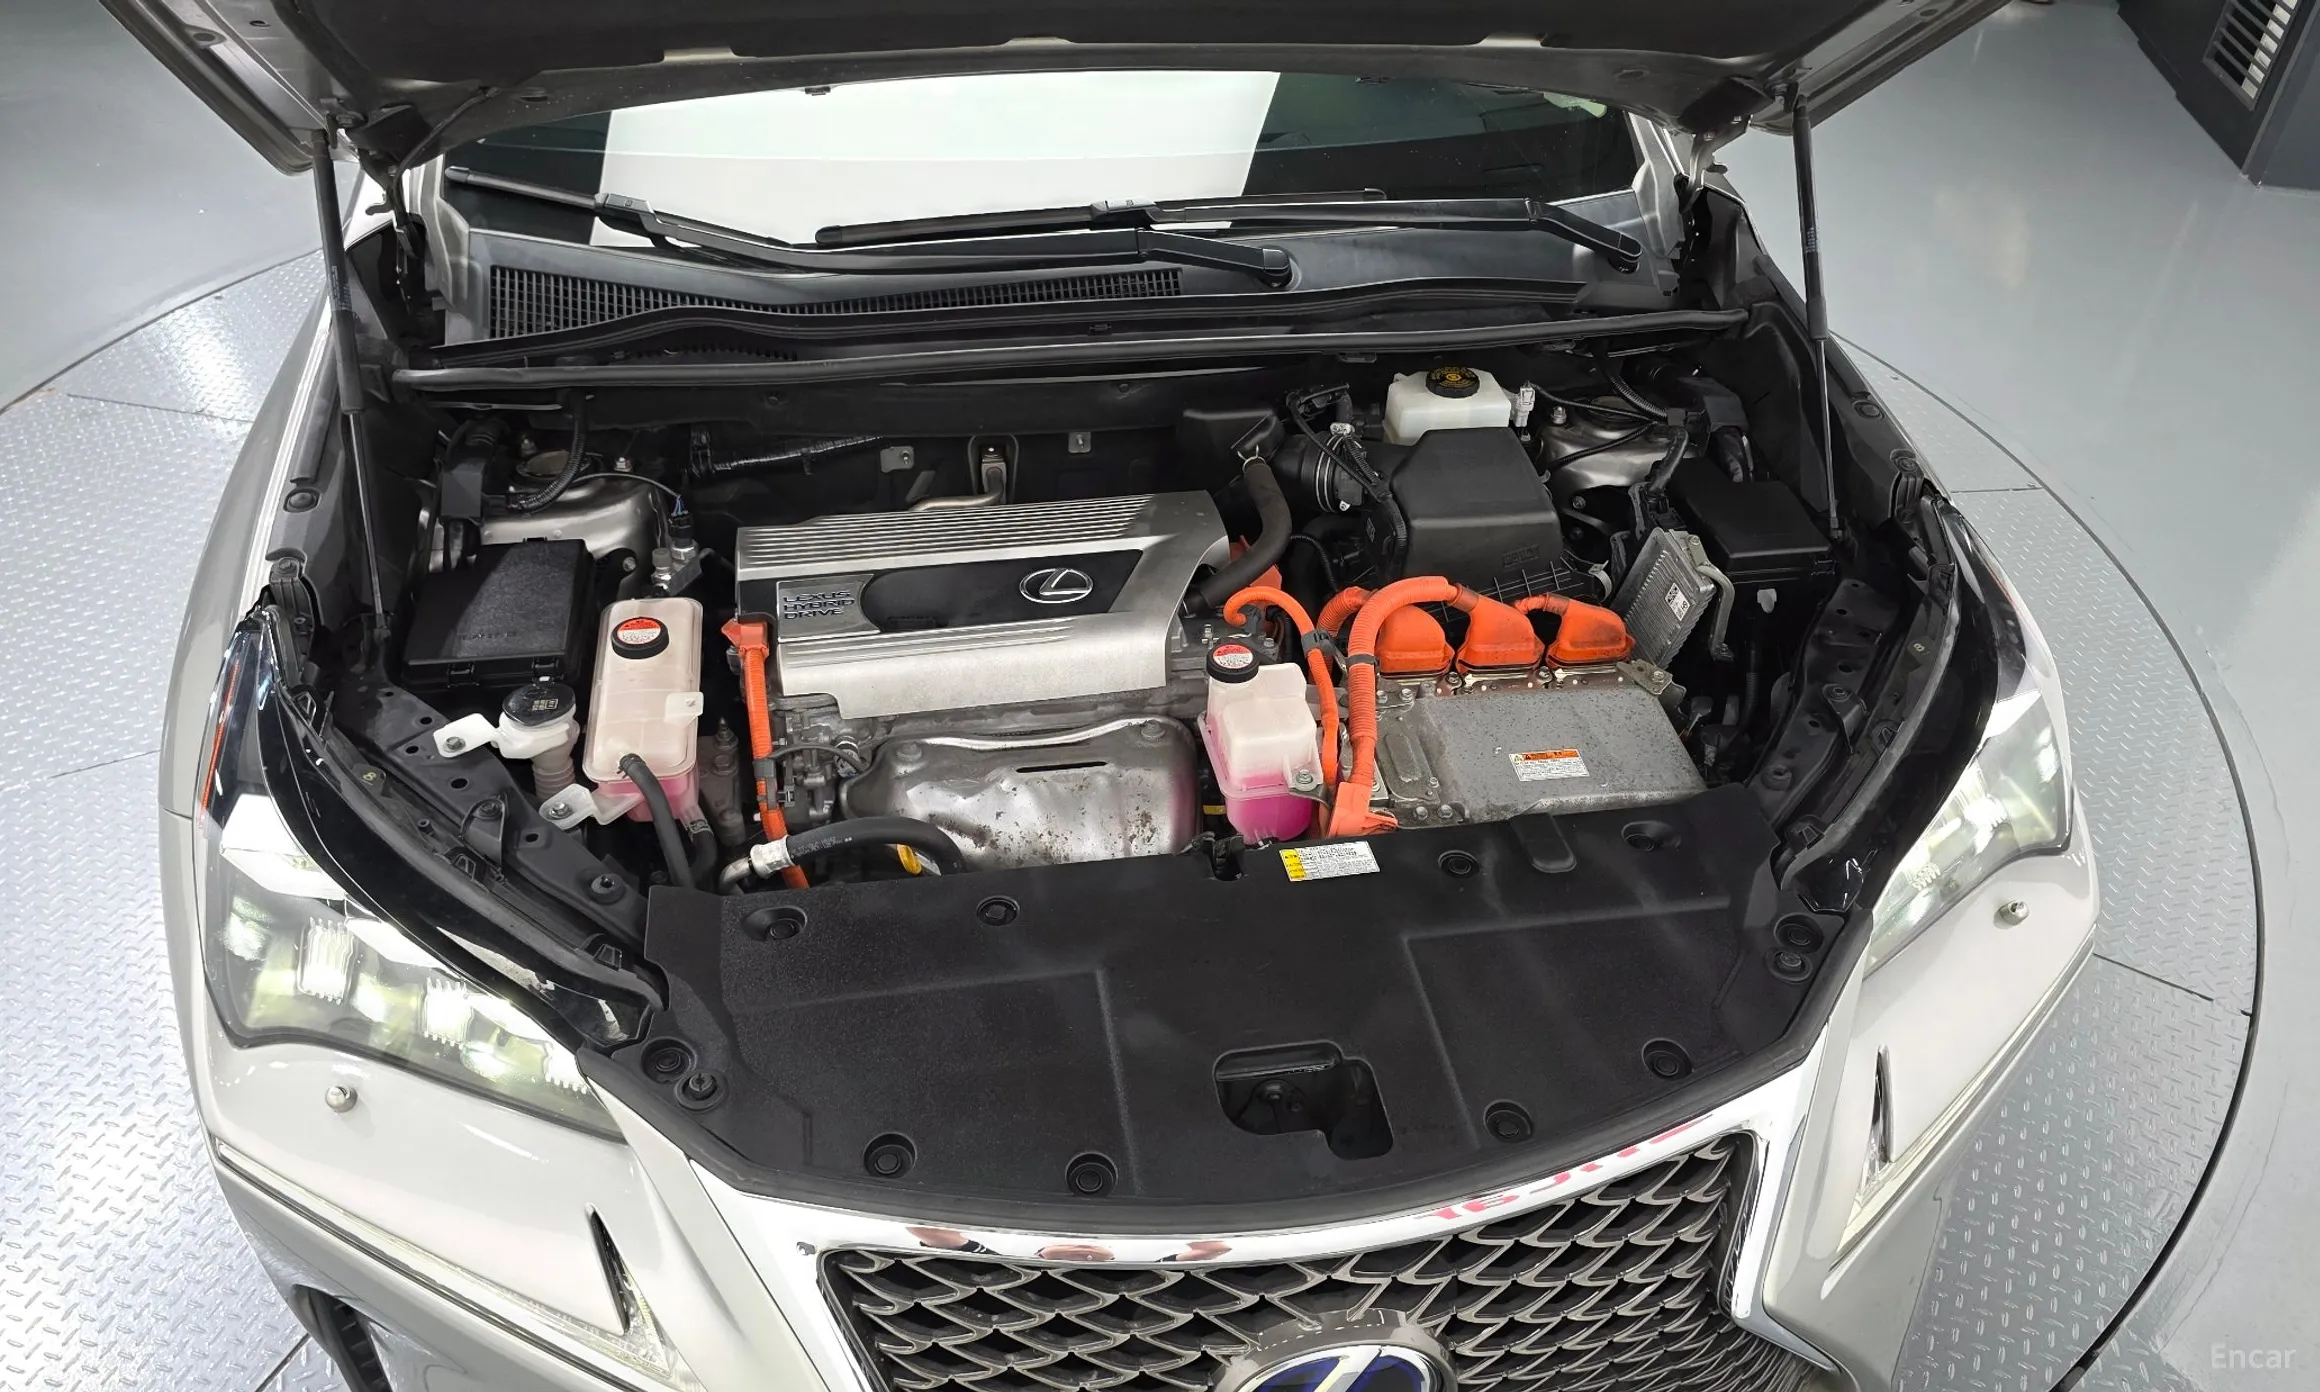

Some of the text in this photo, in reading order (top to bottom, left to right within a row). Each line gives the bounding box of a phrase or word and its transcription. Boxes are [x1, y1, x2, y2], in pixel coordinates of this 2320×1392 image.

[783, 590, 851, 602] LEXUS
[783, 598, 855, 611] HYBRID
[784, 608, 844, 620] DRIVE
